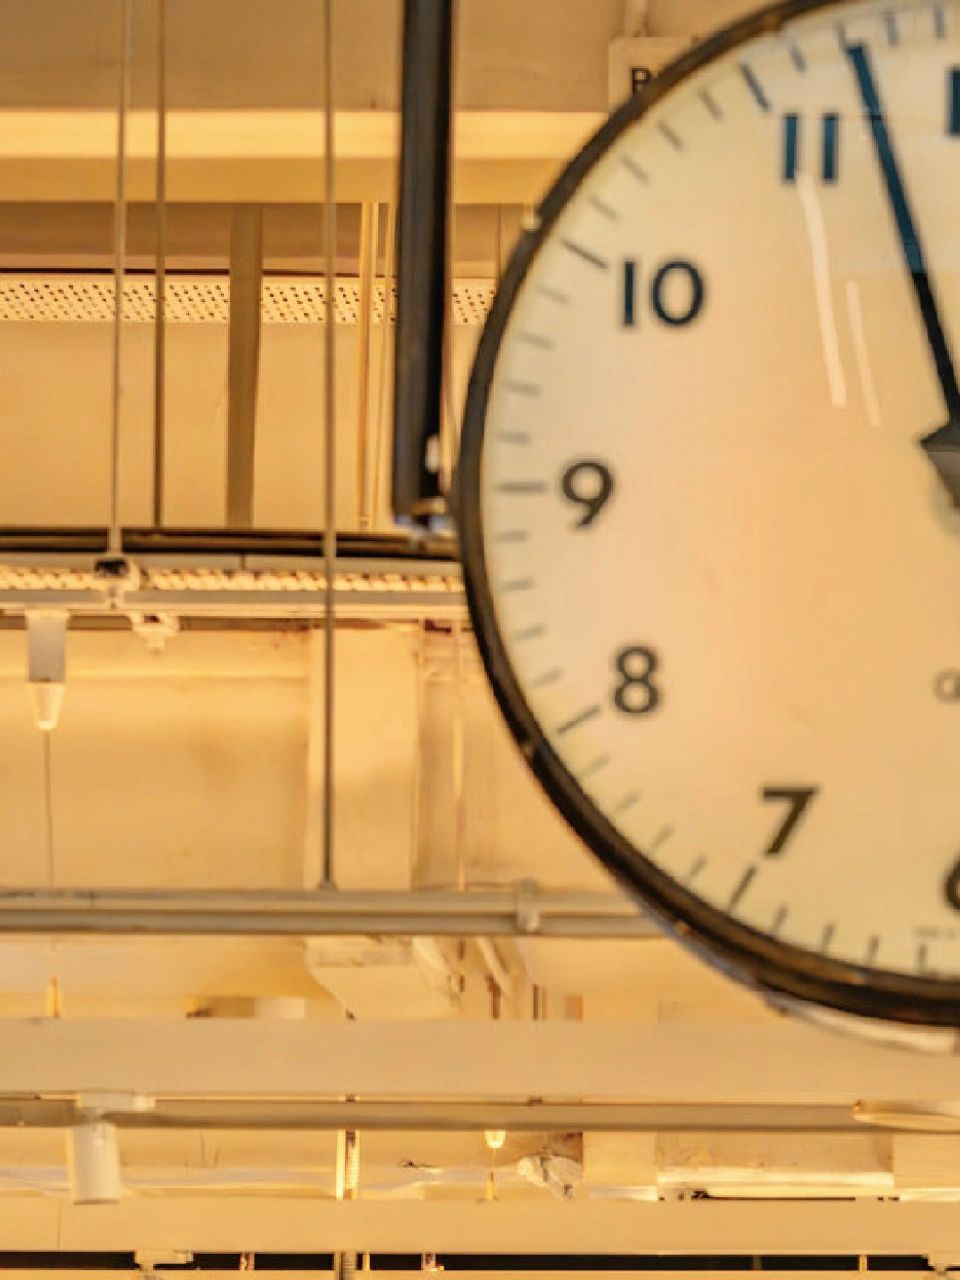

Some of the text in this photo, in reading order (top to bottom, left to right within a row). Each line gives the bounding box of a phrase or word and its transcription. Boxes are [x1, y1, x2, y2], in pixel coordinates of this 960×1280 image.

[781, 112, 840, 184] 11
[620, 259, 705, 328] 10
[561, 458, 615, 530] 9
[611, 645, 661, 716] 8
[760, 785, 819, 857] 7
